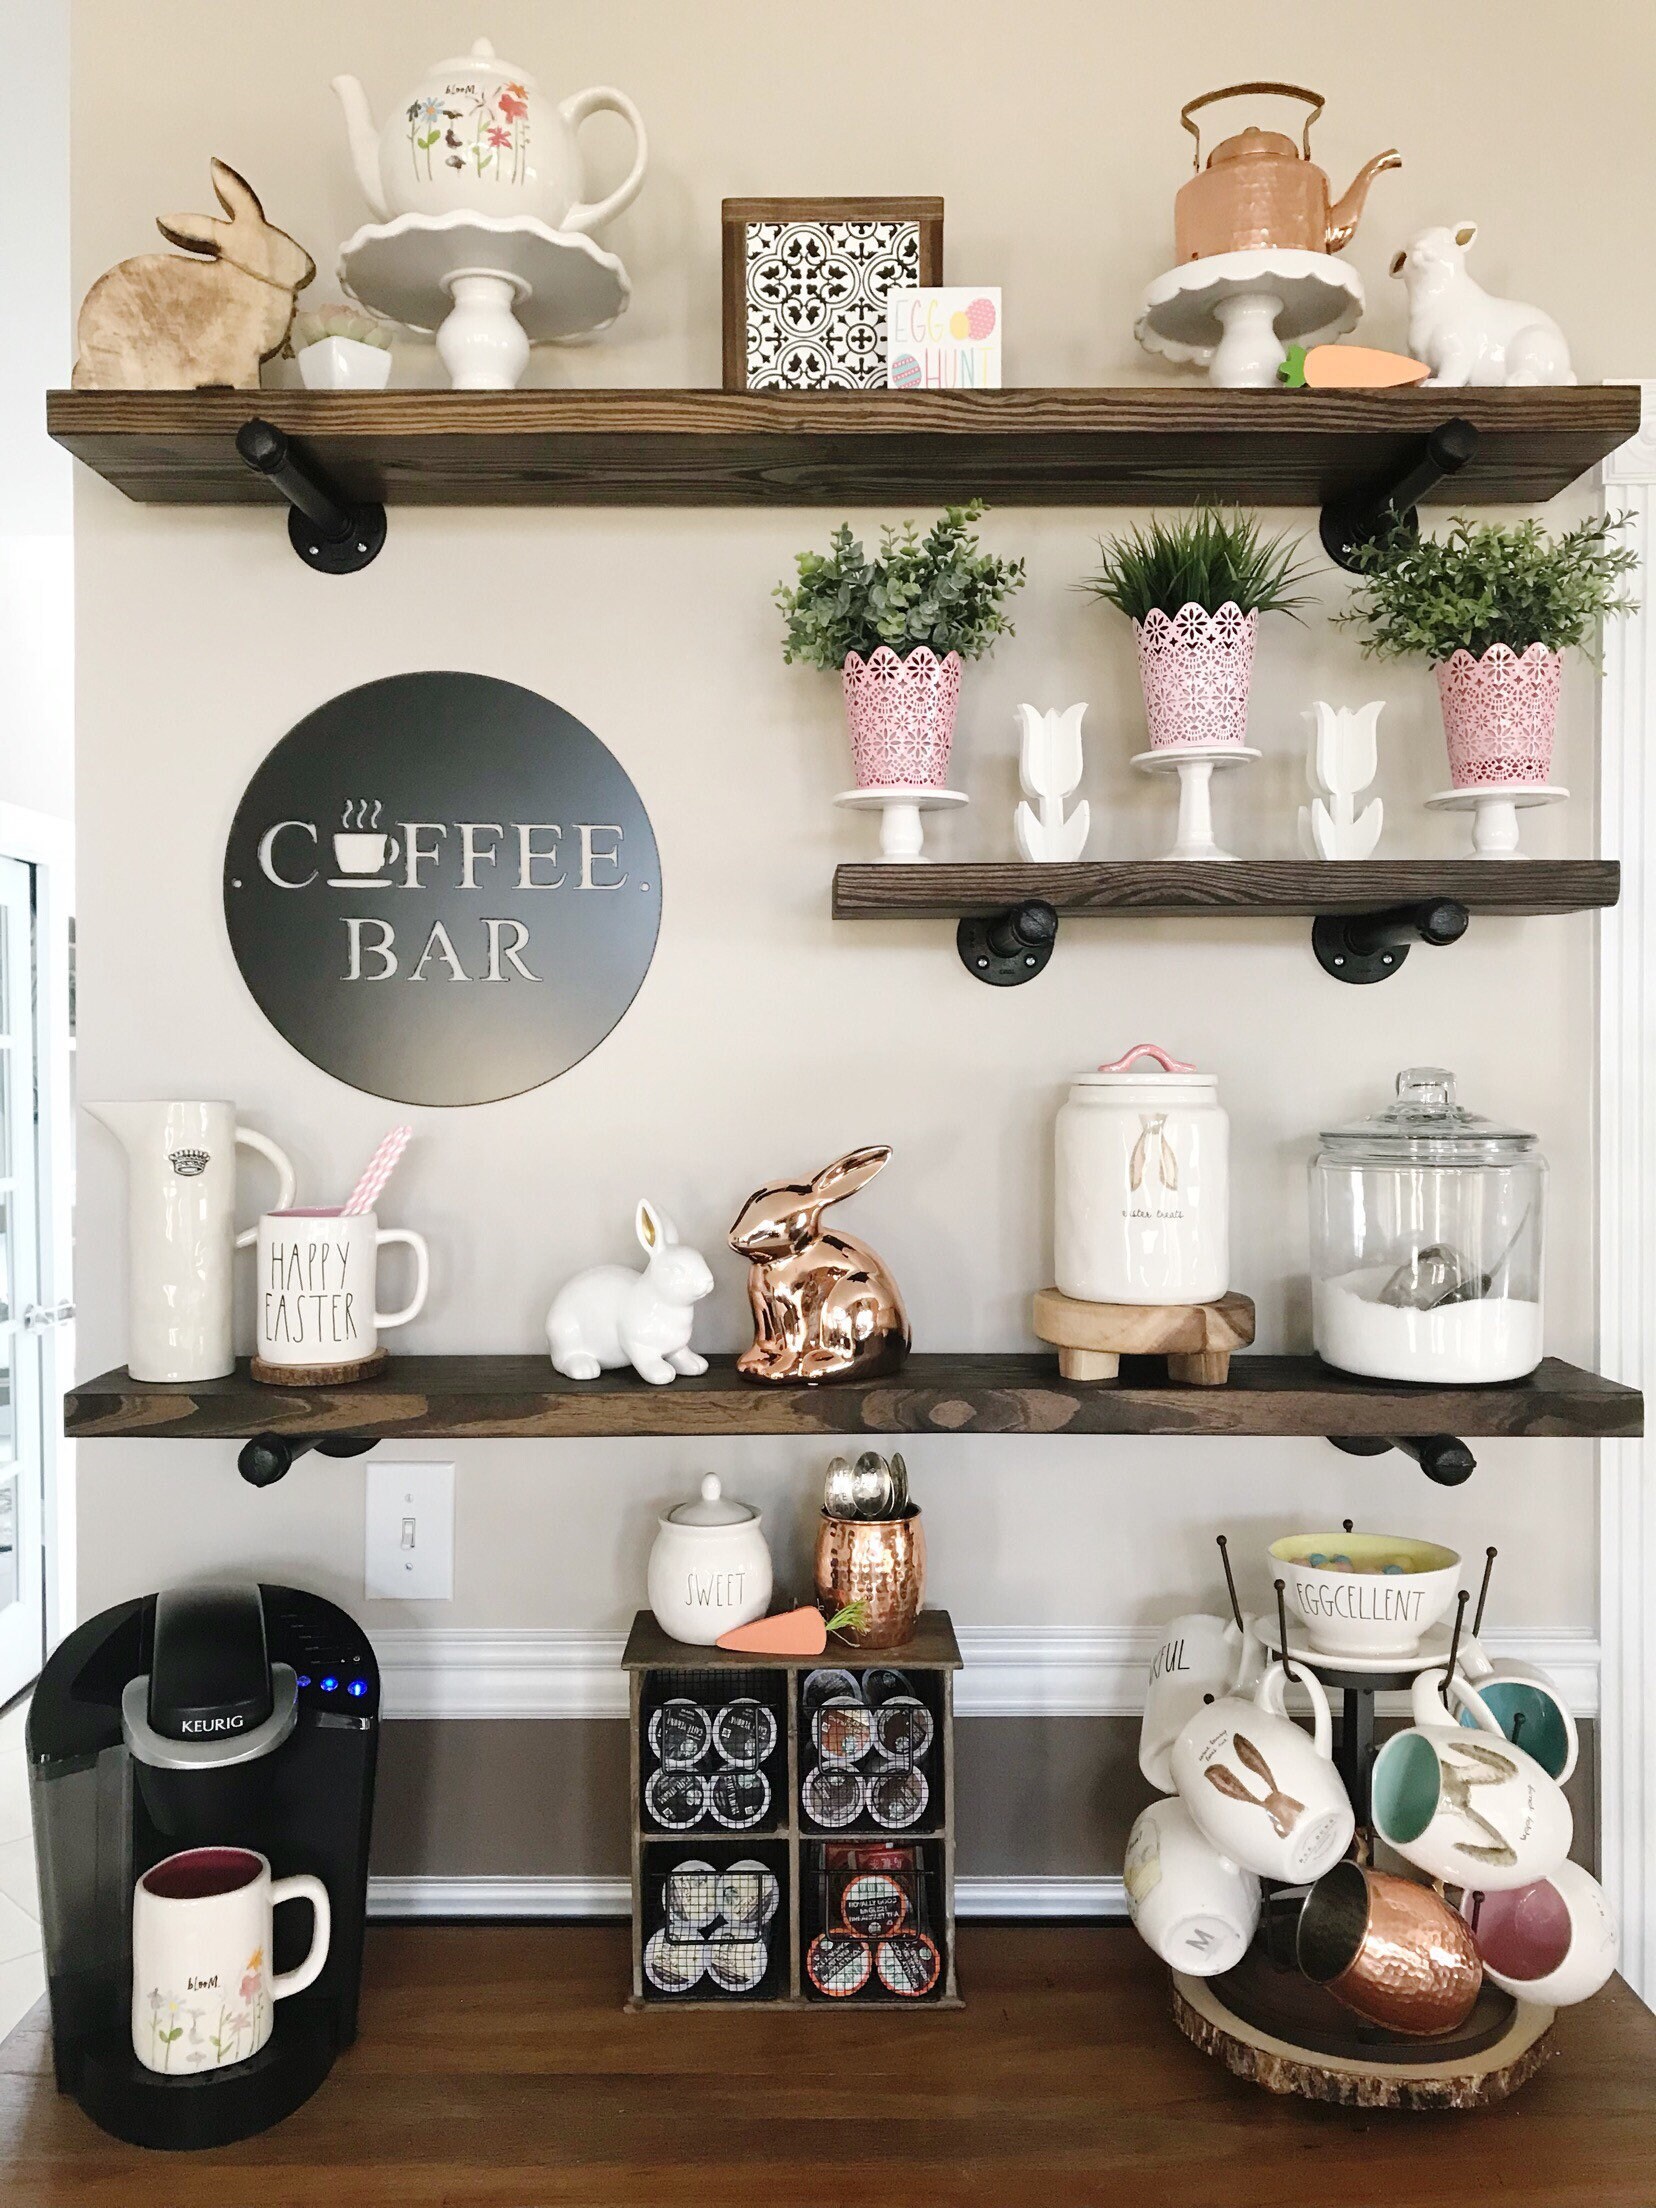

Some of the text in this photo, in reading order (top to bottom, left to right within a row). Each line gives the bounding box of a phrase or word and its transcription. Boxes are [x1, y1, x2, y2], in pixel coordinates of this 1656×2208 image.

[895, 299, 943, 343] EGG
[925, 347, 993, 388] HUNT
[257, 821, 629, 890] CFFEE
[340, 916, 543, 982] BAR
[1122, 1209, 1152, 1219] ester
[271, 1241, 350, 1291] HAPPY
[265, 1293, 357, 1342] EASTER
[685, 1572, 746, 1608] SWEET
[1296, 1583, 1425, 1621] EGGCELLENT
[181, 1715, 244, 1733] KEURIG
